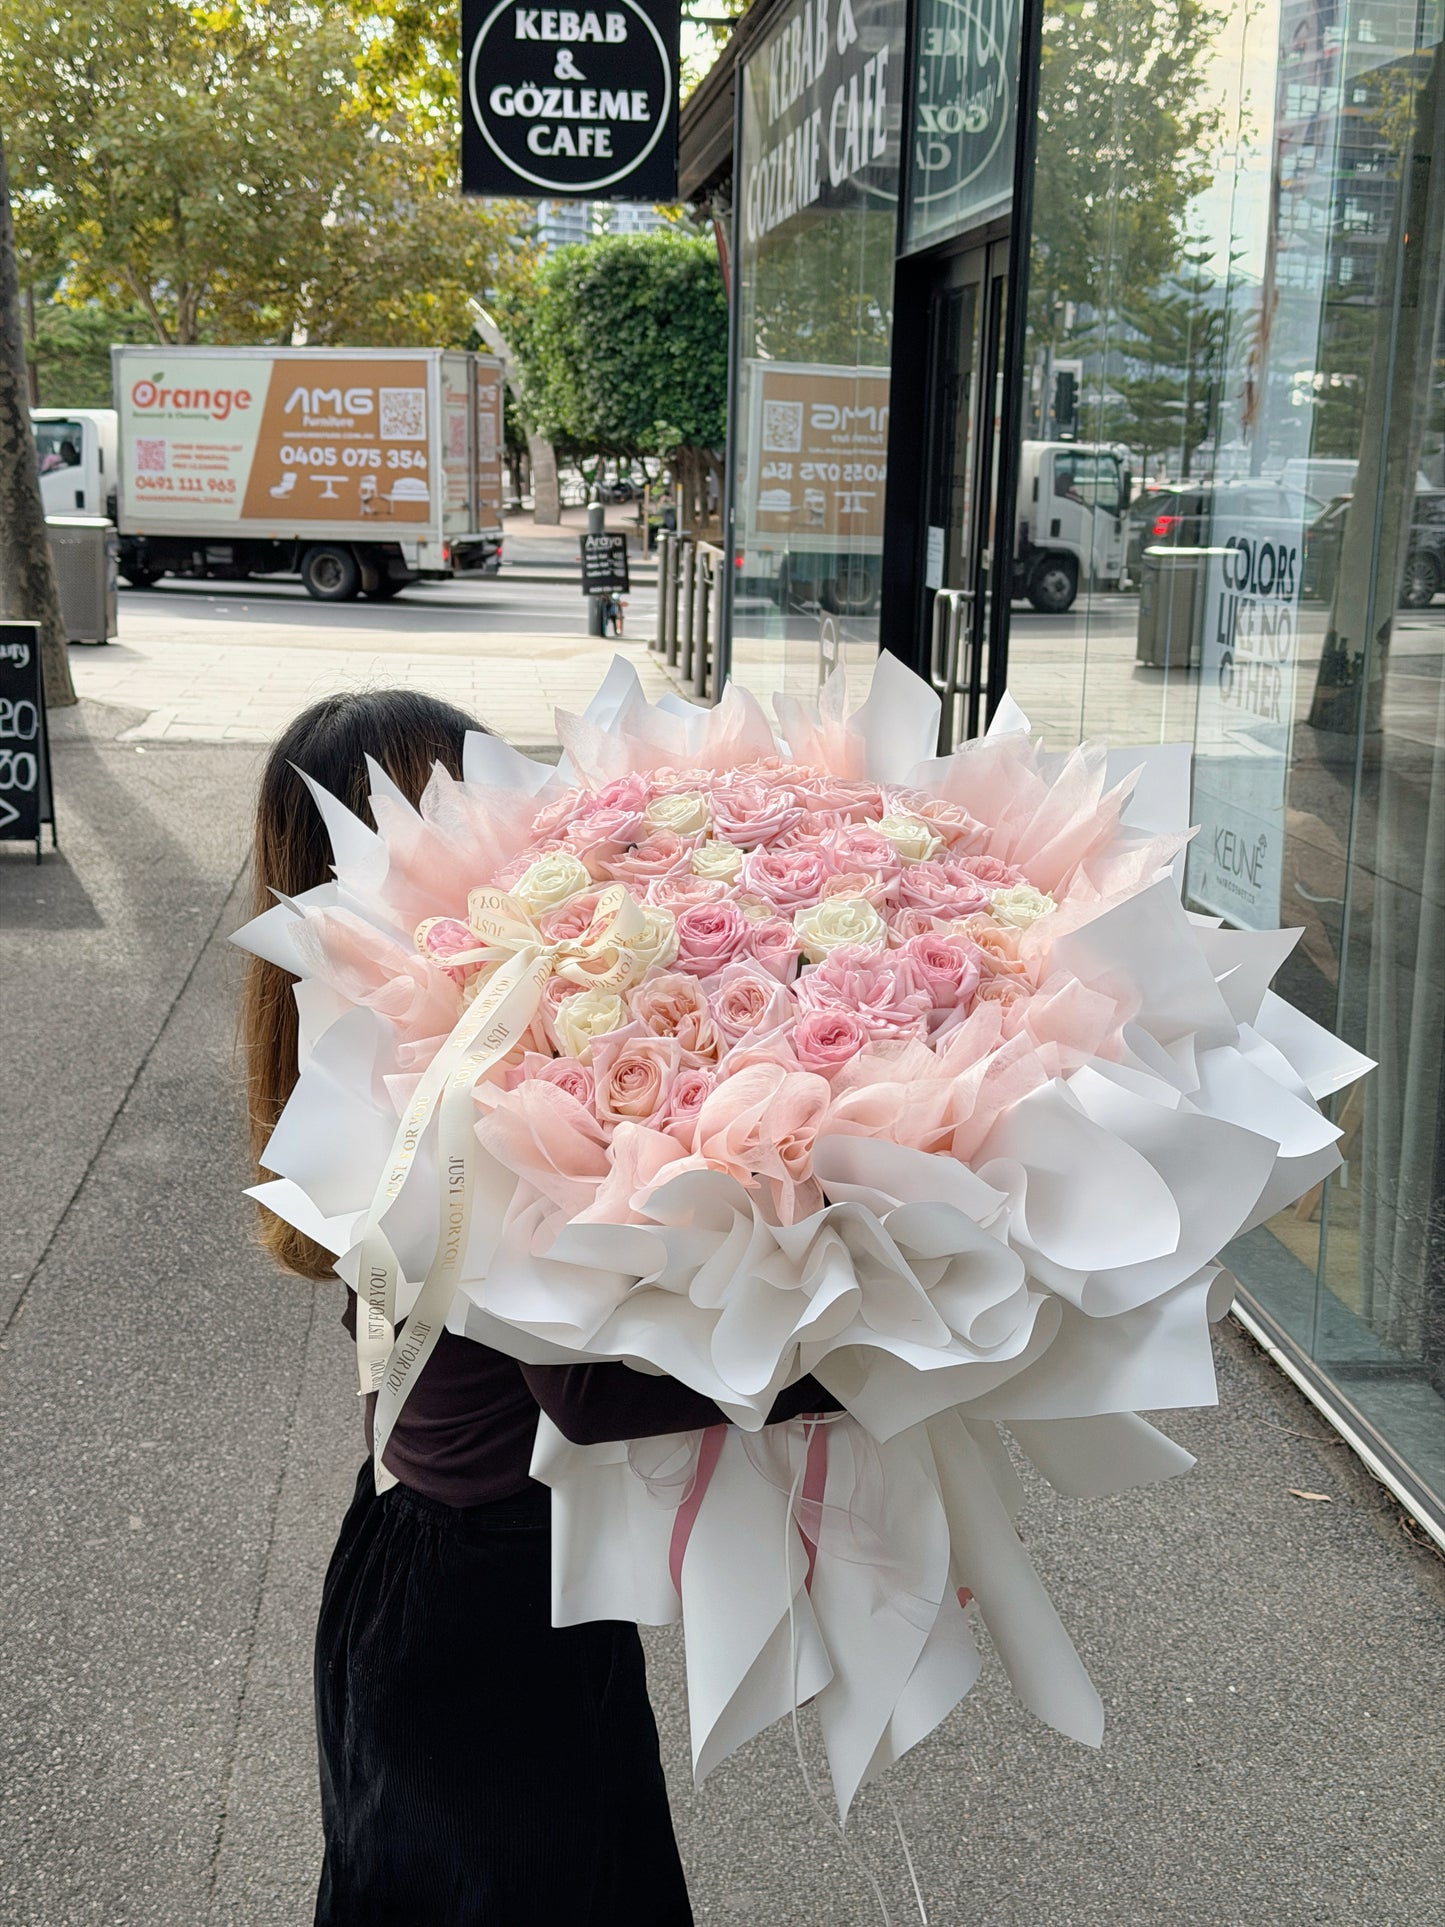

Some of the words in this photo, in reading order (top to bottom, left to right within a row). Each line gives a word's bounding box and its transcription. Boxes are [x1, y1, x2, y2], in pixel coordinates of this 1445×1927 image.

[515, 8, 628, 43] KEBAB
[553, 48, 588, 80] &
[769, 0, 828, 127] KEBAB
[489, 80, 651, 121] GÖZLEME
[828, 45, 889, 188] CAFE
[526, 124, 614, 158] CAFE
[131, 380, 253, 421] Orange
[284, 387, 375, 415] AMG
[279, 445, 338, 467] 0405
[341, 447, 383, 468] 075
[386, 449, 428, 470] 354
[135, 475, 174, 491] 0491
[178, 477, 203, 492] 111
[1222, 536, 1297, 604] COLORS
[1216, 592, 1257, 653] LIKE
[1260, 602, 1292, 664] NO
[1218, 650, 1282, 724] OTHER
[1214, 825, 1264, 889] KEUNE
[612, 953, 633, 983] FOR
[483, 1022, 511, 1055] JUST
[409, 1095, 430, 1127] YOU
[448, 1155, 466, 1195] JUST
[448, 1202, 466, 1238] FOR
[440, 1238, 462, 1271] YOU
[369, 1266, 388, 1297] YOU
[368, 1297, 386, 1321] FOR
[367, 1321, 386, 1341] JUST
[409, 1320, 432, 1348] JUST
[400, 1343, 421, 1371] FOR
[386, 1367, 408, 1397] YOU
